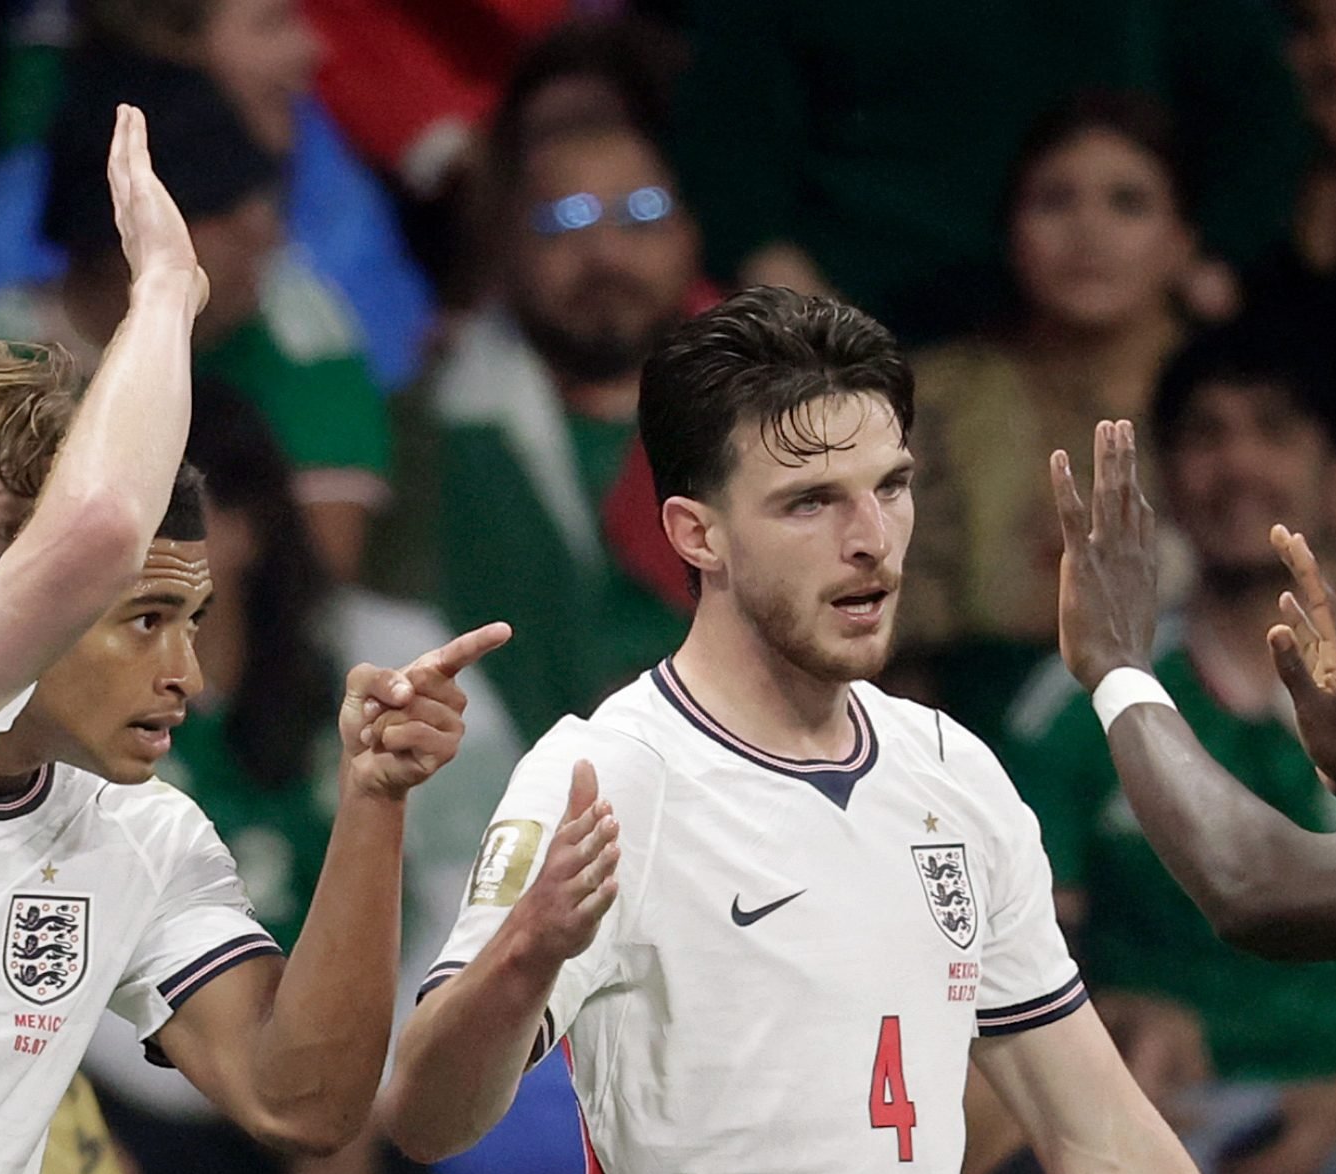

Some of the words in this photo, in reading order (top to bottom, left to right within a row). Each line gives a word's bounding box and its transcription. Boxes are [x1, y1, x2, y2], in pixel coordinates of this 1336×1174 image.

[14, 1013, 68, 1032] MEXIC
[14, 1034, 48, 1056] 05.07
[869, 1015, 917, 1163] 4
